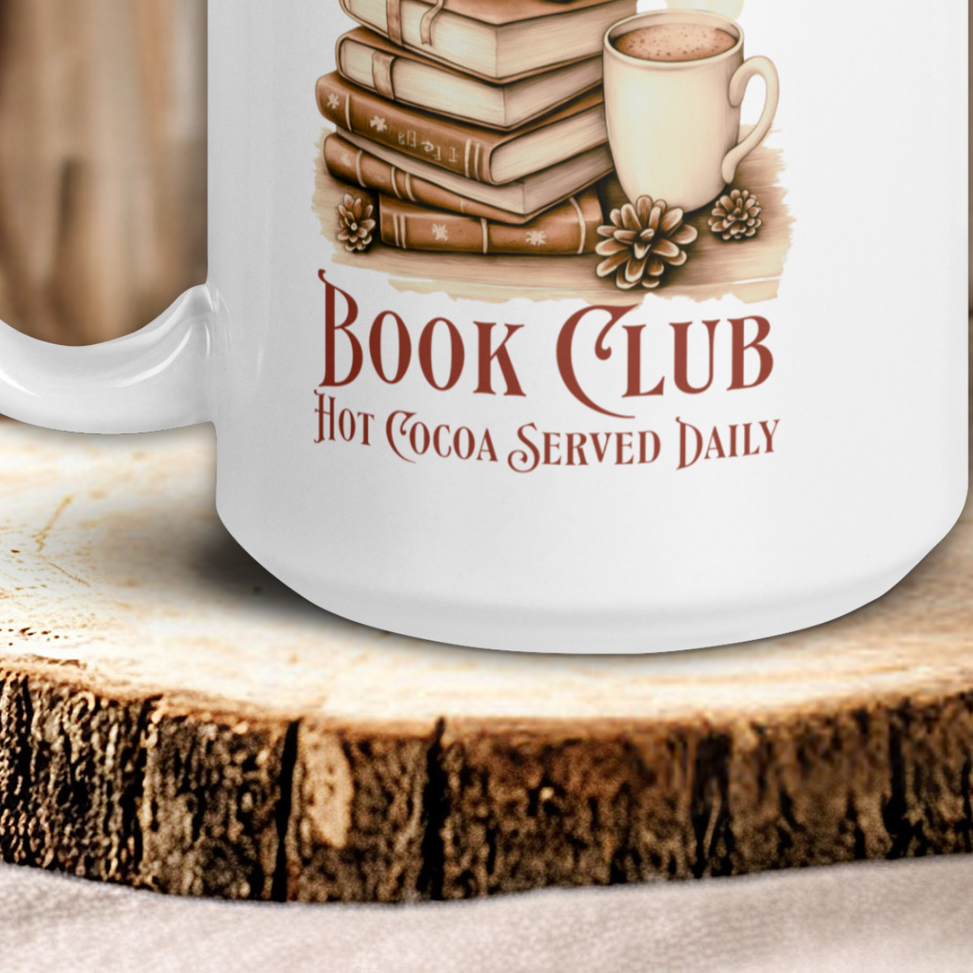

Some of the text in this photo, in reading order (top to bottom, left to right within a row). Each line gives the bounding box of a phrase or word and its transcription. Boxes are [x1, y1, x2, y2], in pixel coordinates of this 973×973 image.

[317, 269, 775, 419] BOOK CLUB
[313, 389, 781, 474] HOT COCOA SERVED DAILY
